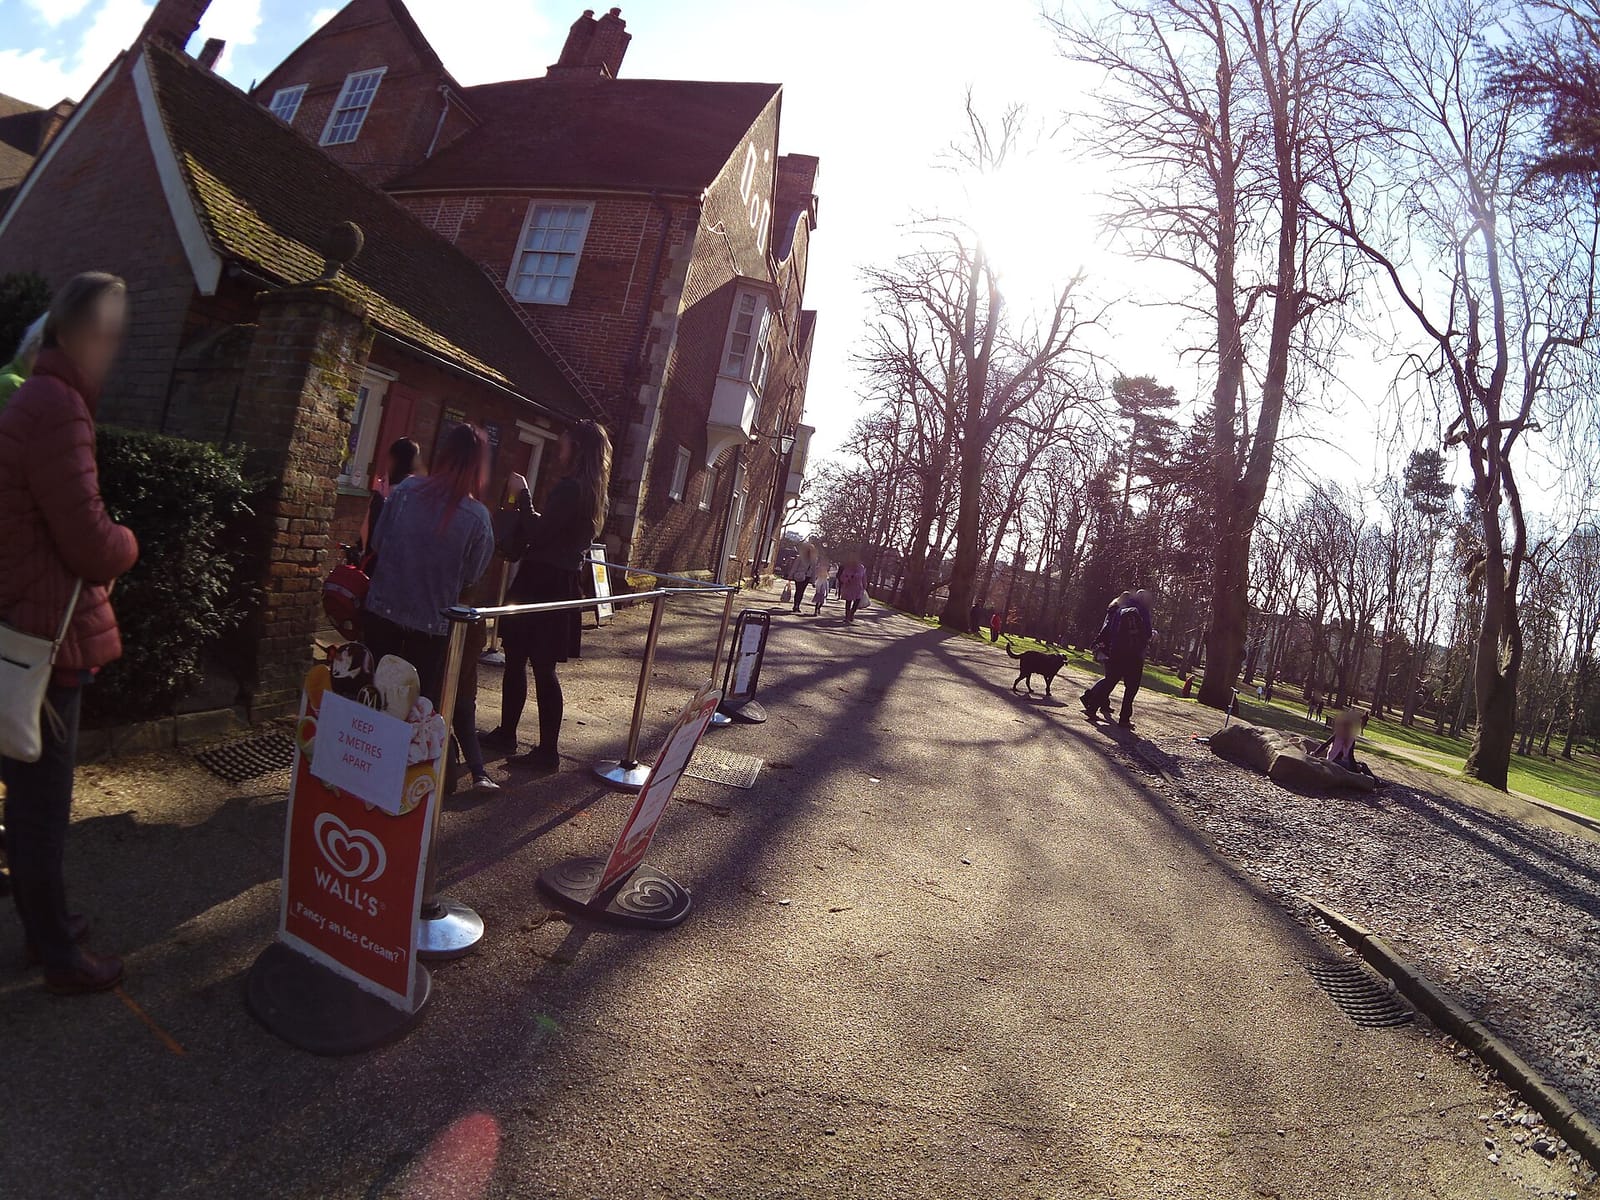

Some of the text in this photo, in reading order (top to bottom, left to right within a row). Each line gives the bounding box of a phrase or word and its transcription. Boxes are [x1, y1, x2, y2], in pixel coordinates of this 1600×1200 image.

[352, 717, 374, 735] KEEP
[338, 731, 382, 759] 2 METRES
[342, 752, 373, 773] APART
[314, 866, 378, 916] WALL'S
[296, 901, 399, 963] Fancy an Ice Cream?
